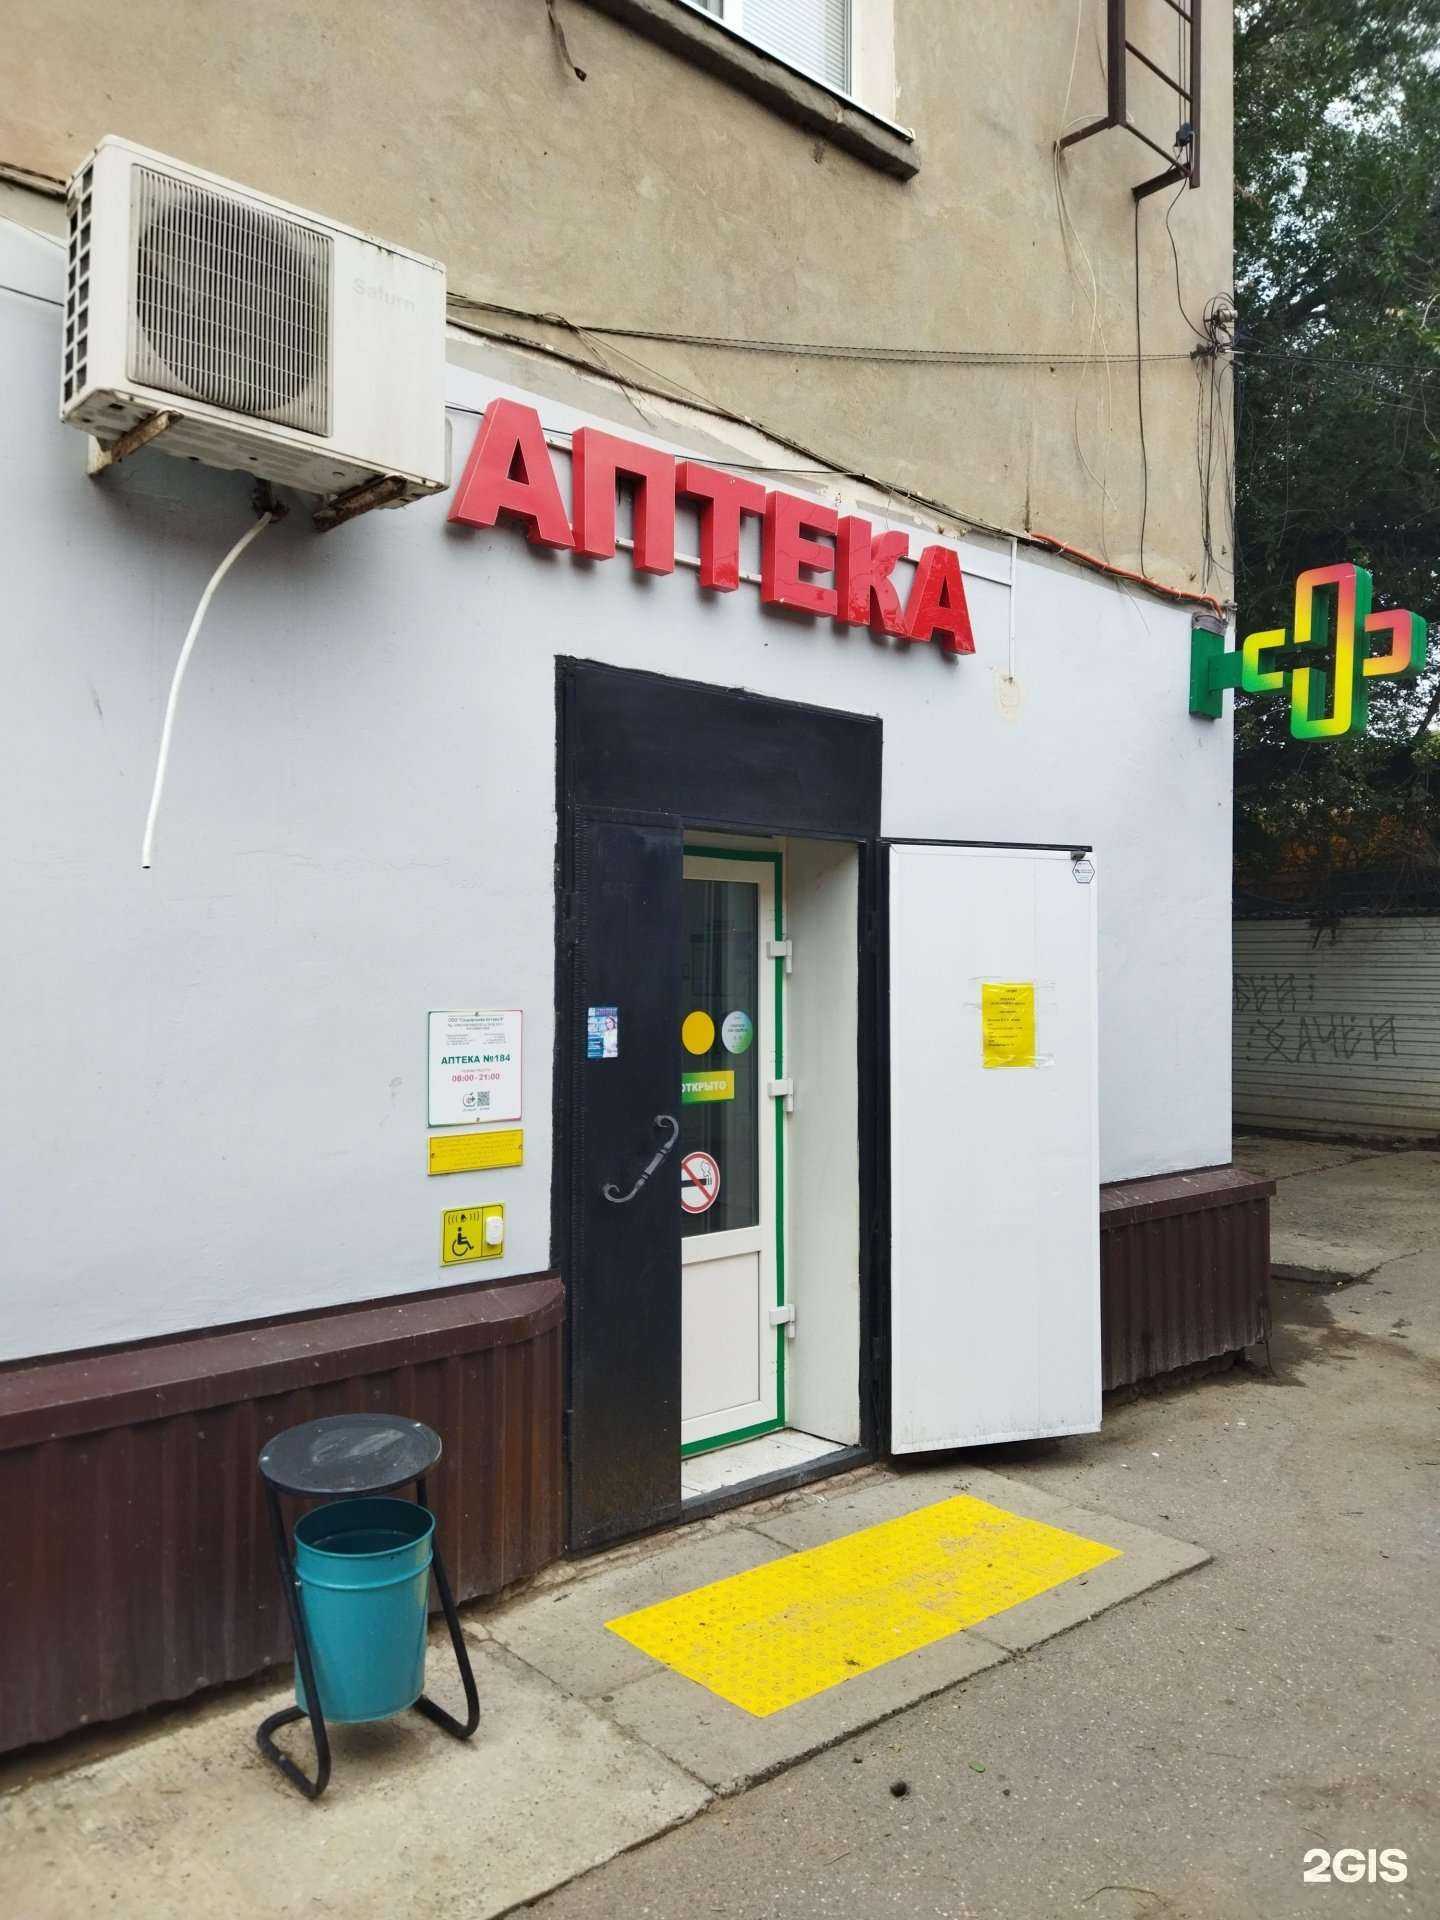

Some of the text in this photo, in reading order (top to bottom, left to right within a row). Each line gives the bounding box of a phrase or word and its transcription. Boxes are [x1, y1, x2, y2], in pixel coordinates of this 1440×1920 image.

[352, 277, 415, 313] Saturn
[446, 397, 976, 655] АПТЕКА
[441, 1053, 511, 1065] АПТЕКА №184
[478, 1072, 500, 1081] 21:00
